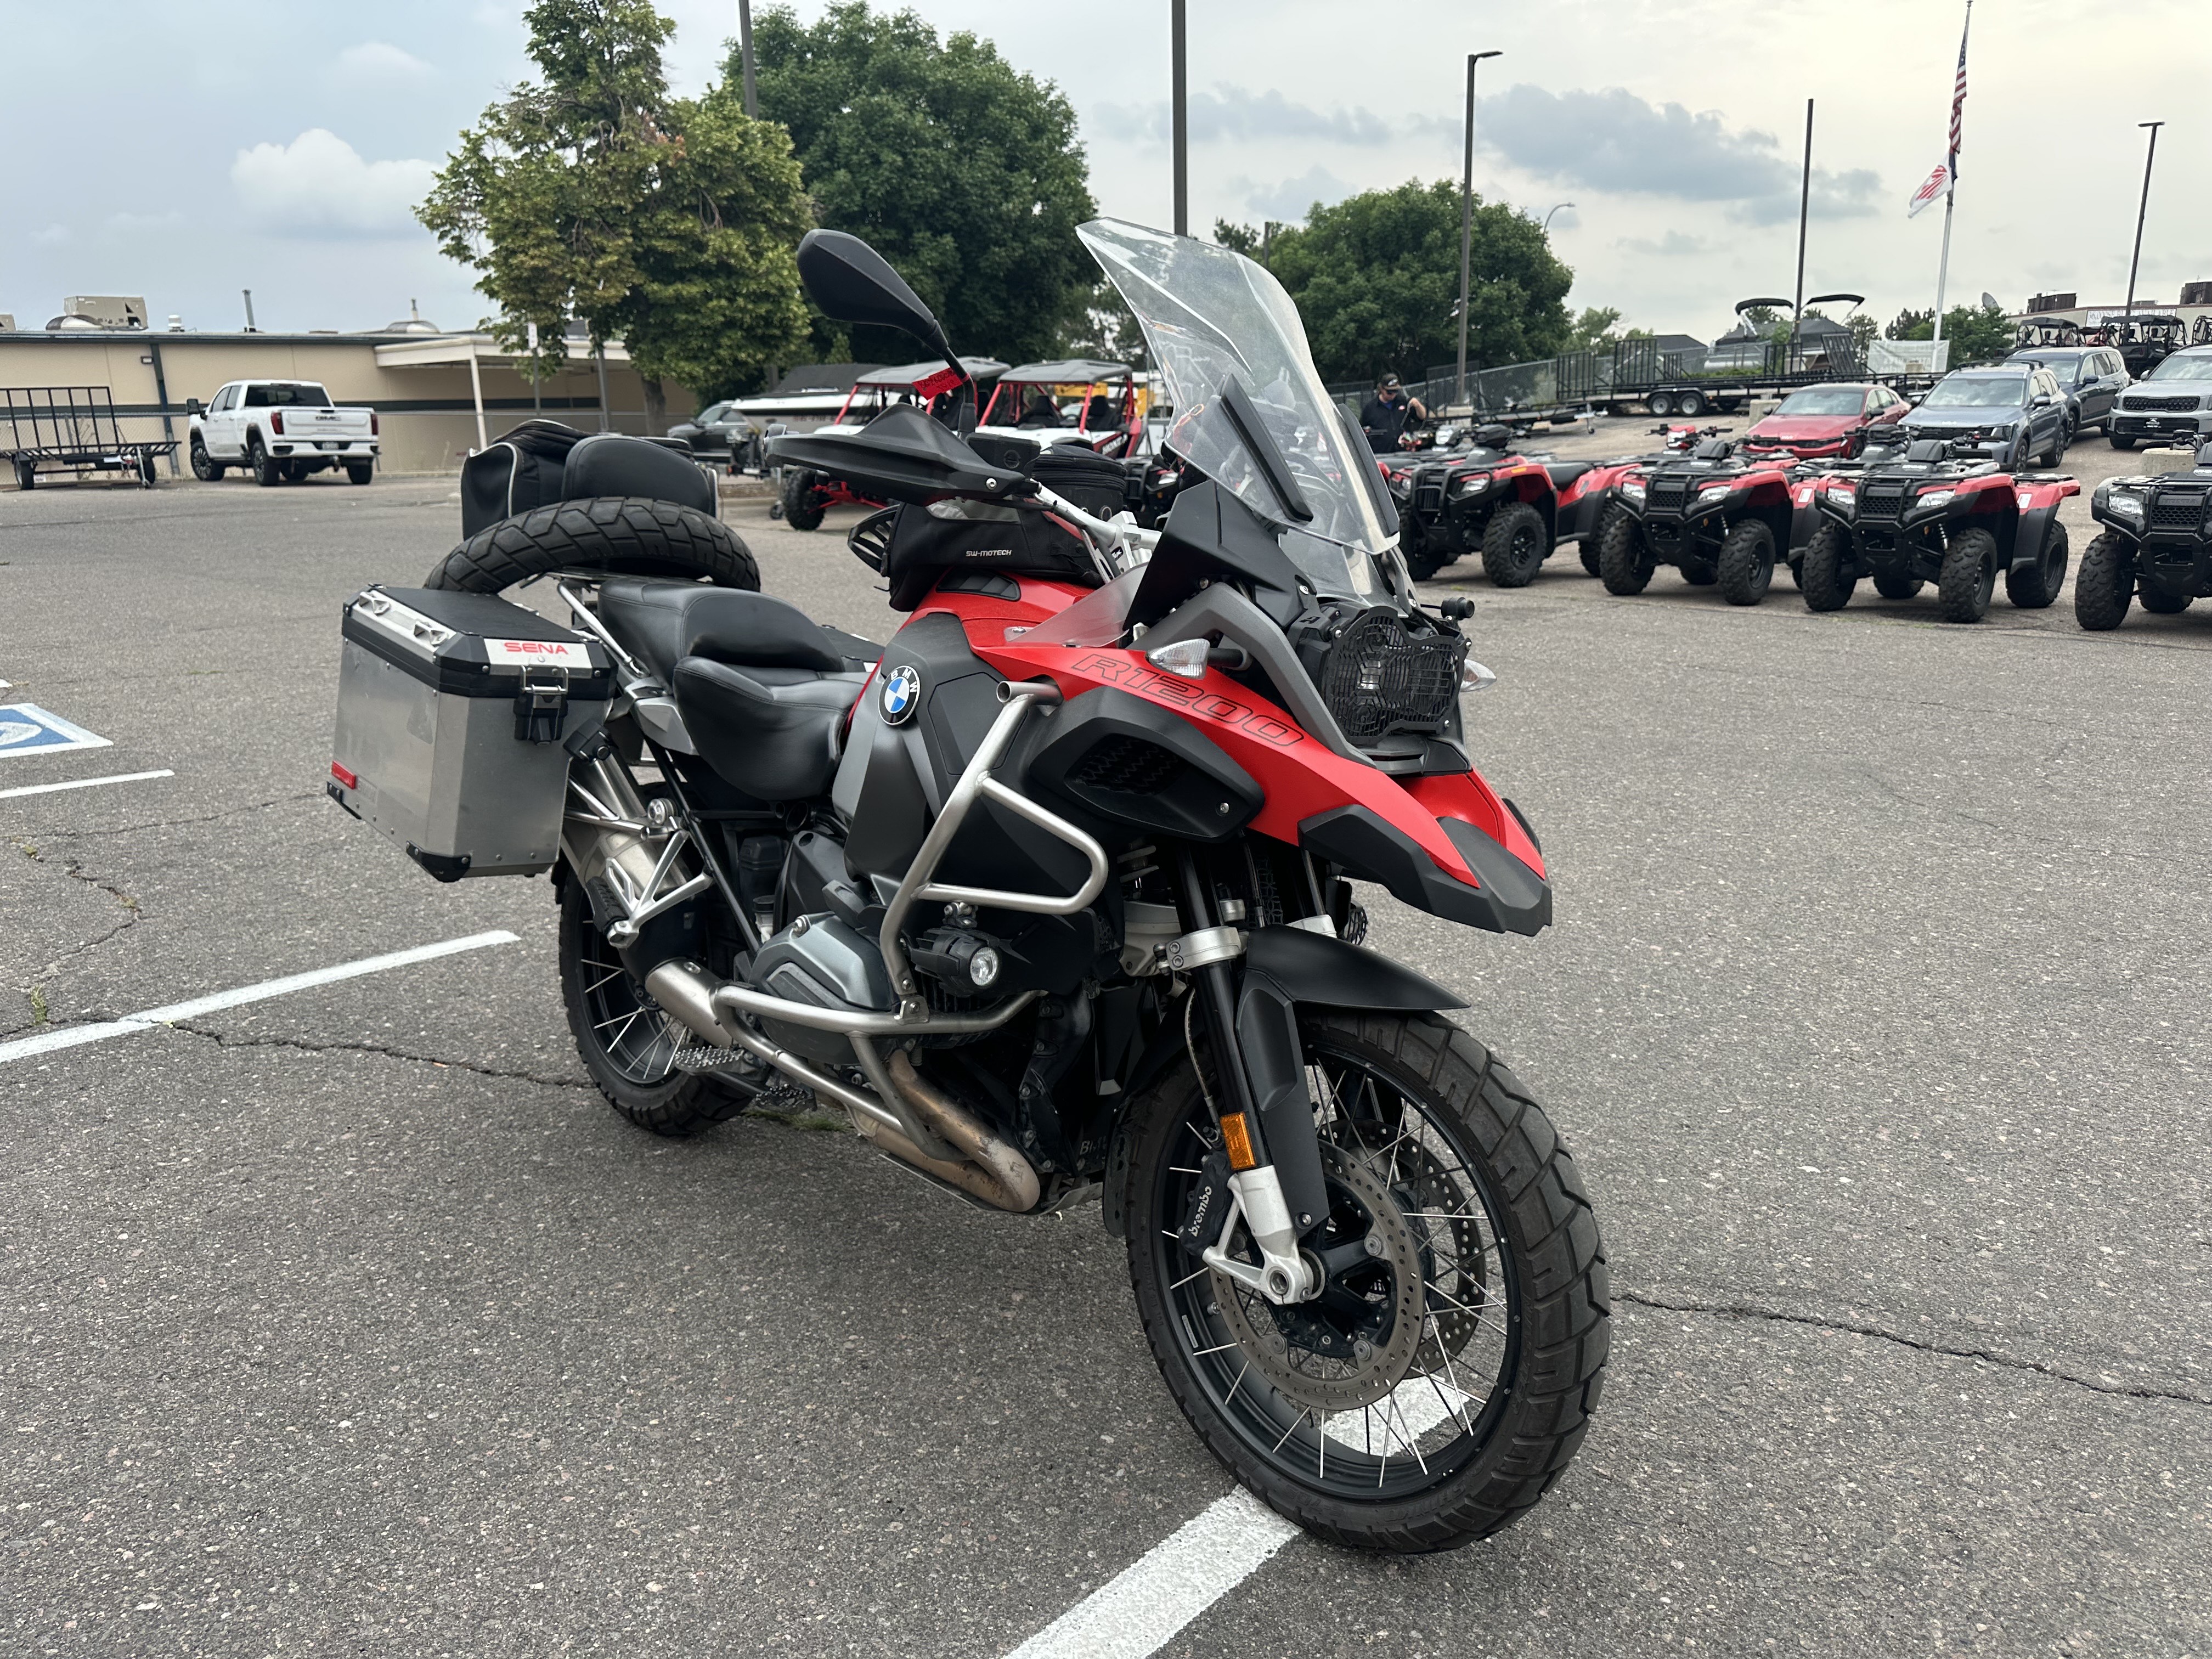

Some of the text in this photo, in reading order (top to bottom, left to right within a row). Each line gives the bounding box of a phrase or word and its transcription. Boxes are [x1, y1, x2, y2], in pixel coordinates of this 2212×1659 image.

[504, 642, 568, 654] SENA
[890, 668, 917, 693] BMW
[1071, 654, 1305, 747] R1200
[1188, 1186, 1212, 1237] brembo
